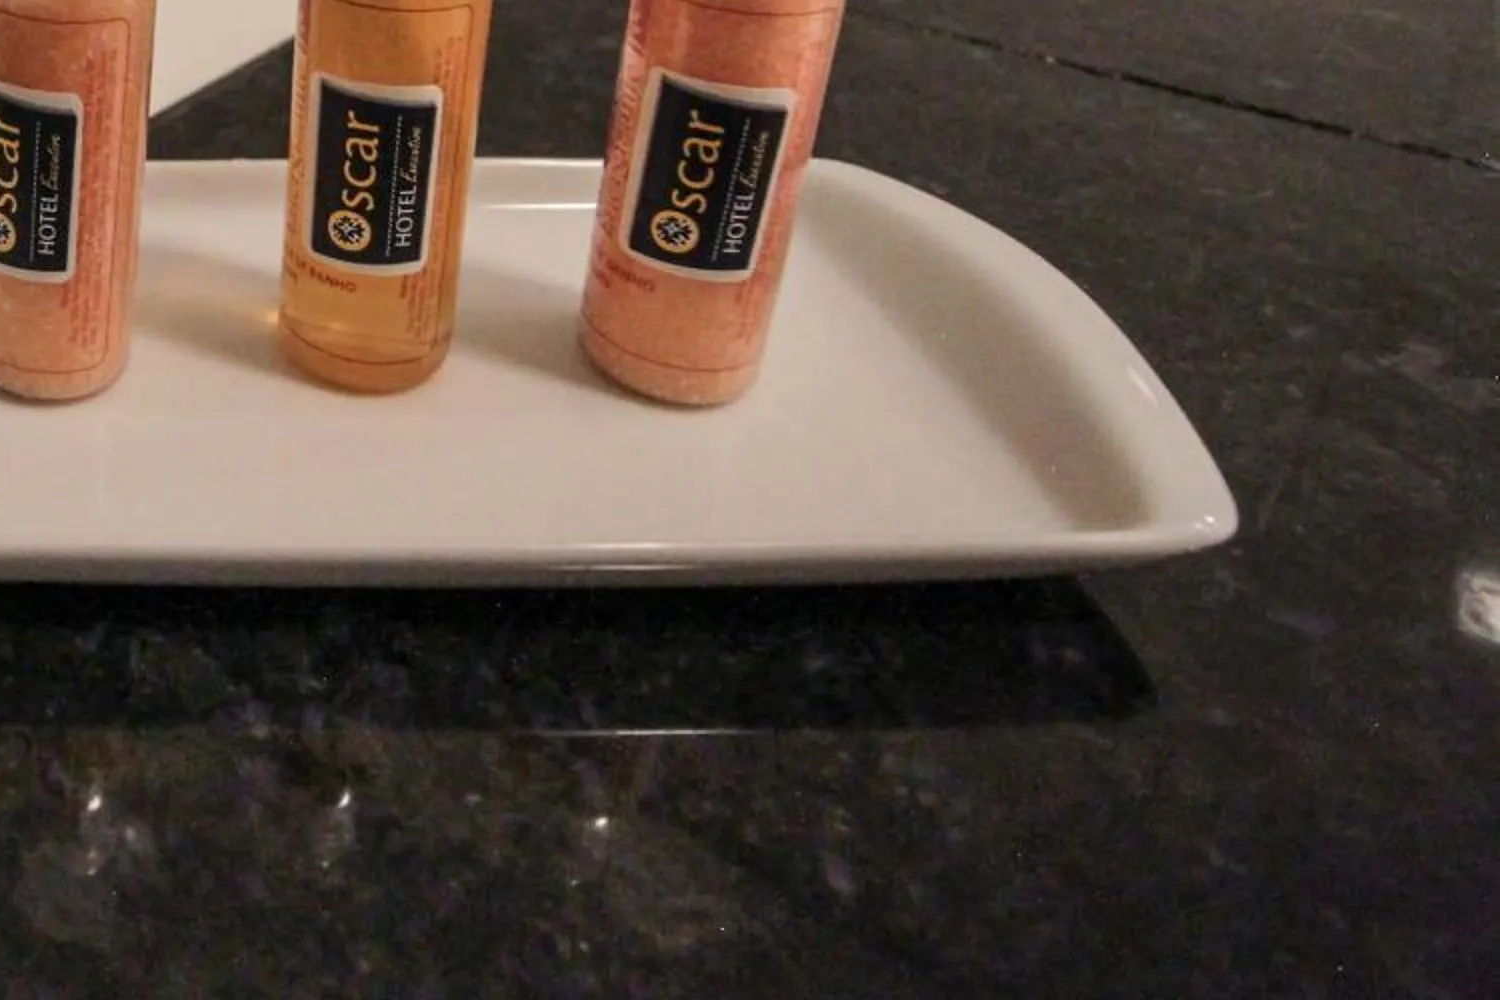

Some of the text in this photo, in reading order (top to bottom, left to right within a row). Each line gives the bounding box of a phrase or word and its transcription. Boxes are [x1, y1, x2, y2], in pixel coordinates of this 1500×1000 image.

[327, 109, 380, 252] Oscar
[650, 108, 725, 254] Oscar
[37, 193, 60, 255] HOTEL
[394, 185, 418, 248] HOTEL
[722, 186, 755, 254] HOTEL
